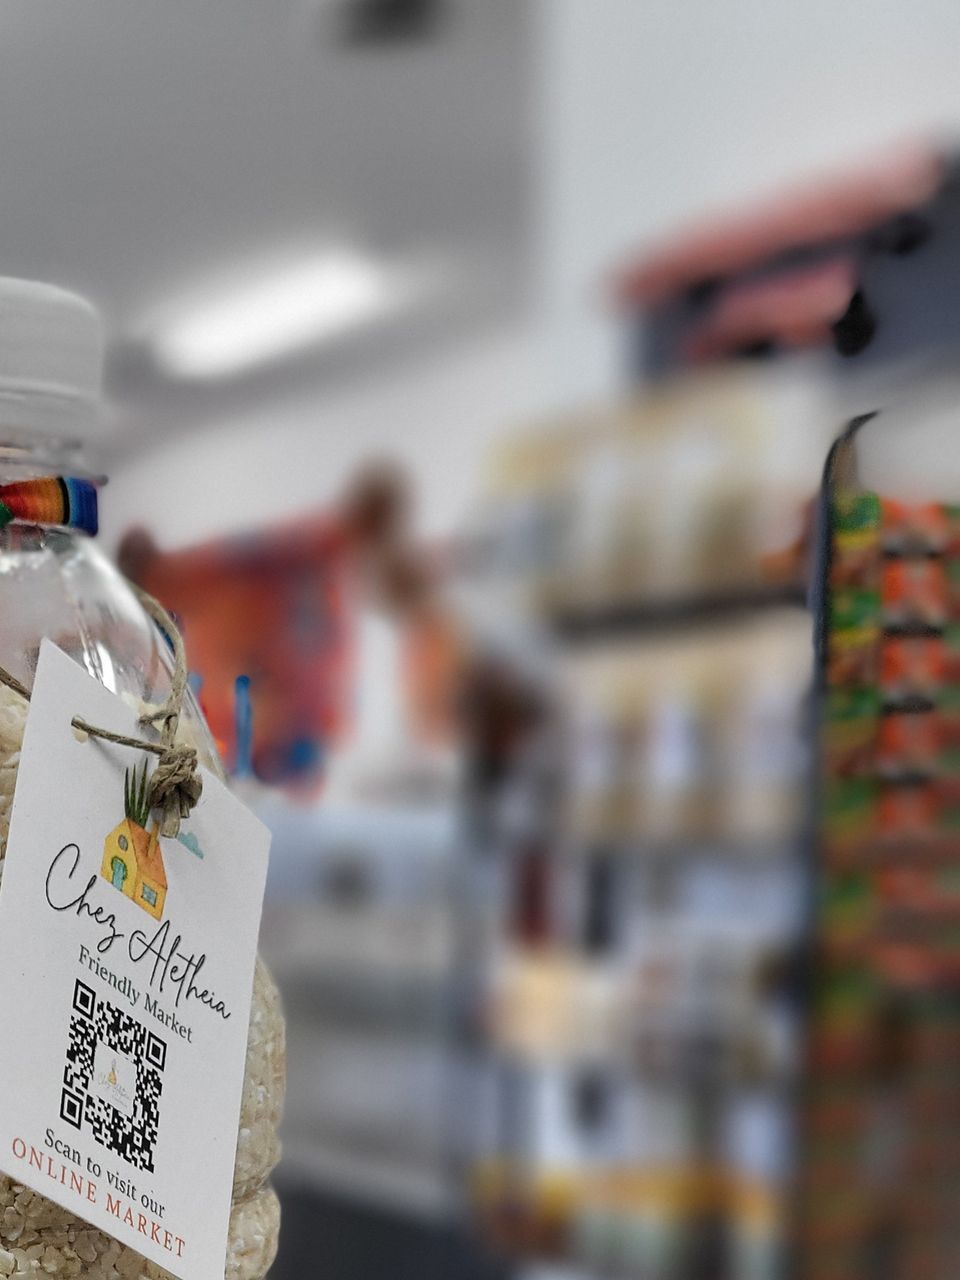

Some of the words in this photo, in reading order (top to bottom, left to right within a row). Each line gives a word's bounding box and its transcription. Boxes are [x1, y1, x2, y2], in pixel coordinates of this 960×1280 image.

[45, 843, 125, 953] Chez
[128, 919, 231, 1020] Aletheia
[78, 944, 140, 1005] Friendly
[143, 991, 193, 1044] Market
[11, 1137, 97, 1204] ONLINE
[105, 1192, 186, 1258] MARKET
[44, 1128, 82, 1166] Scan
[86, 1157, 102, 1178] to
[107, 1170, 137, 1201] visit
[141, 1193, 166, 1219] our
